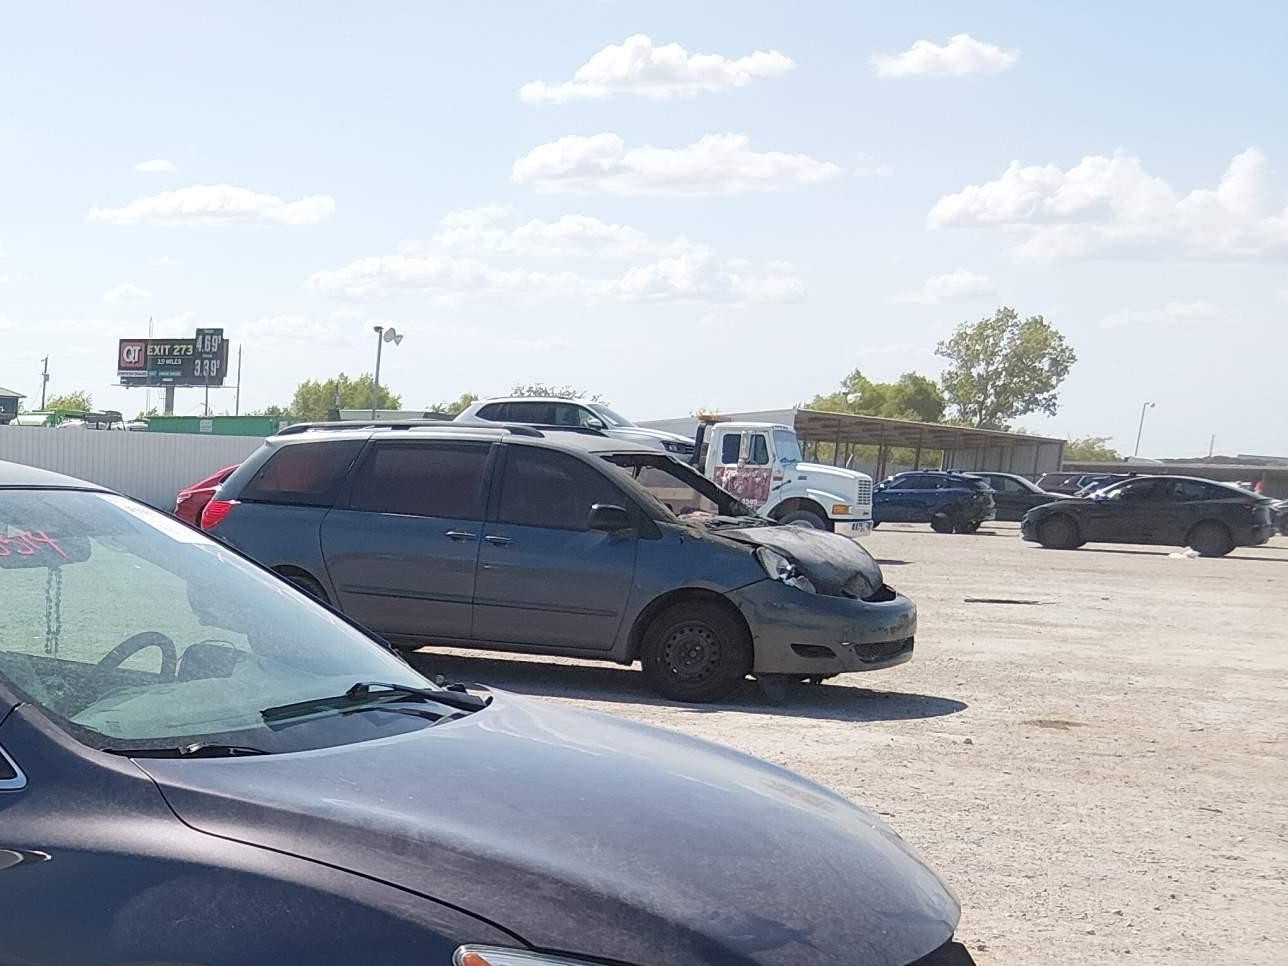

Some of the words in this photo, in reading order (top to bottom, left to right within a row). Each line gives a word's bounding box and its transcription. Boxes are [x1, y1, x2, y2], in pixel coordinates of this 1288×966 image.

[122, 346, 141, 363] QT
[147, 345, 171, 356] EXIT
[173, 345, 193, 356] 273
